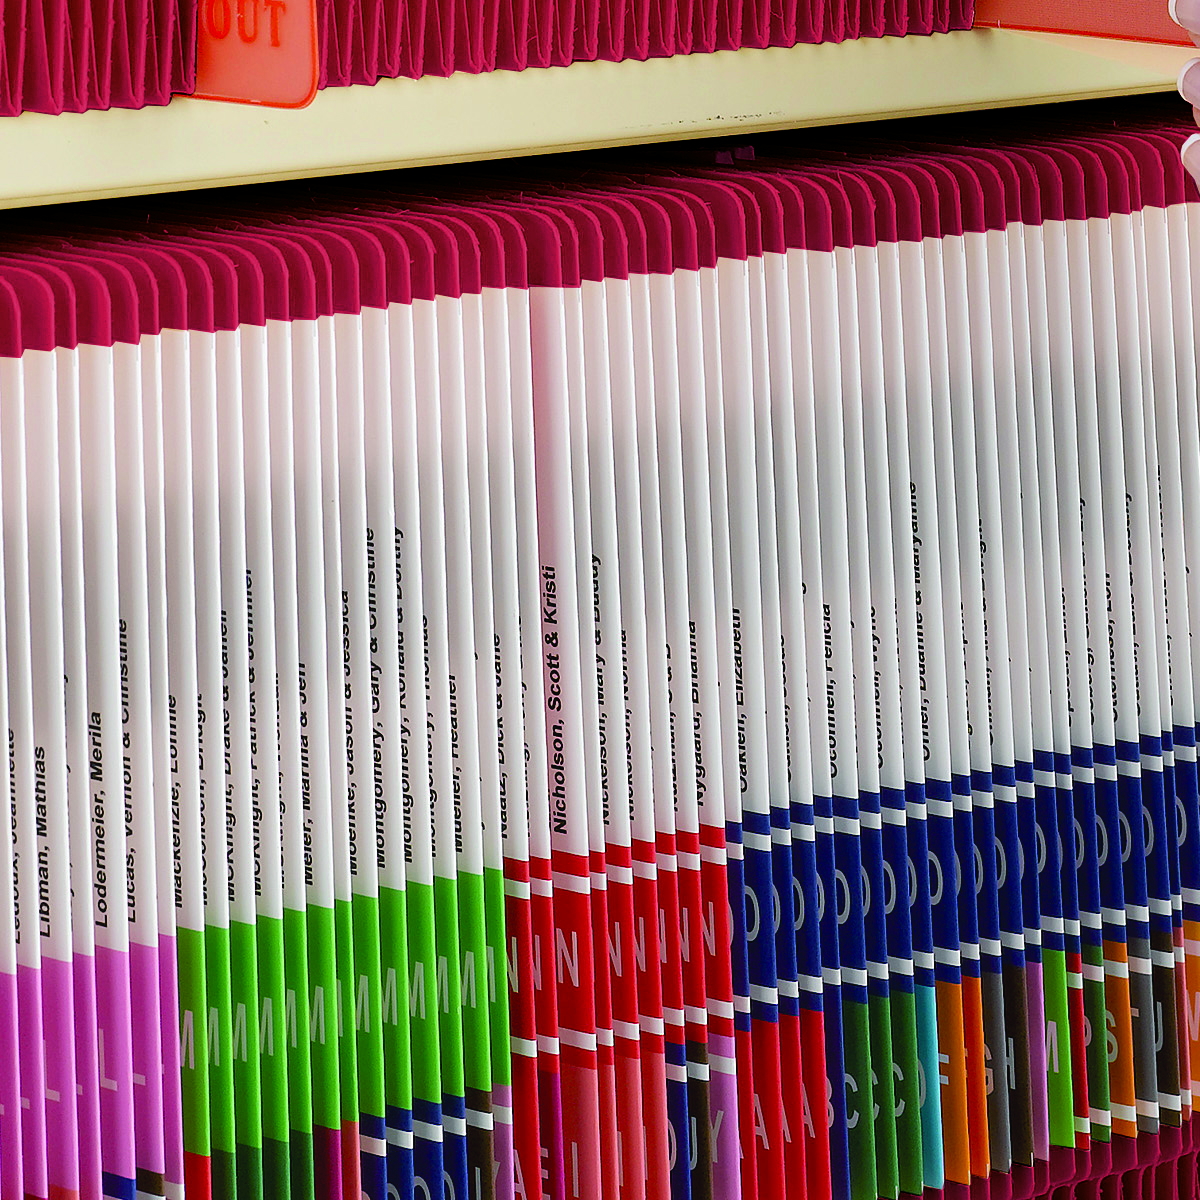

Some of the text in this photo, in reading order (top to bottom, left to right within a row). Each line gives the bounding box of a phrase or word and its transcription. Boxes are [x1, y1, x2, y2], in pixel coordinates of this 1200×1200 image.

[541, 565, 567, 834] Nicholson, Scott & Kristi
[34, 746, 51, 937] Libman, Mathias
[88, 712, 108, 928] Lodermeier, Merila
[608, 923, 622, 977] N
[701, 902, 716, 956] N
[557, 929, 579, 987] N
[100, 1029, 118, 1091] L
[754, 1094, 770, 1149] A
[844, 1073, 859, 1129] C
[709, 1110, 724, 1162] Y
